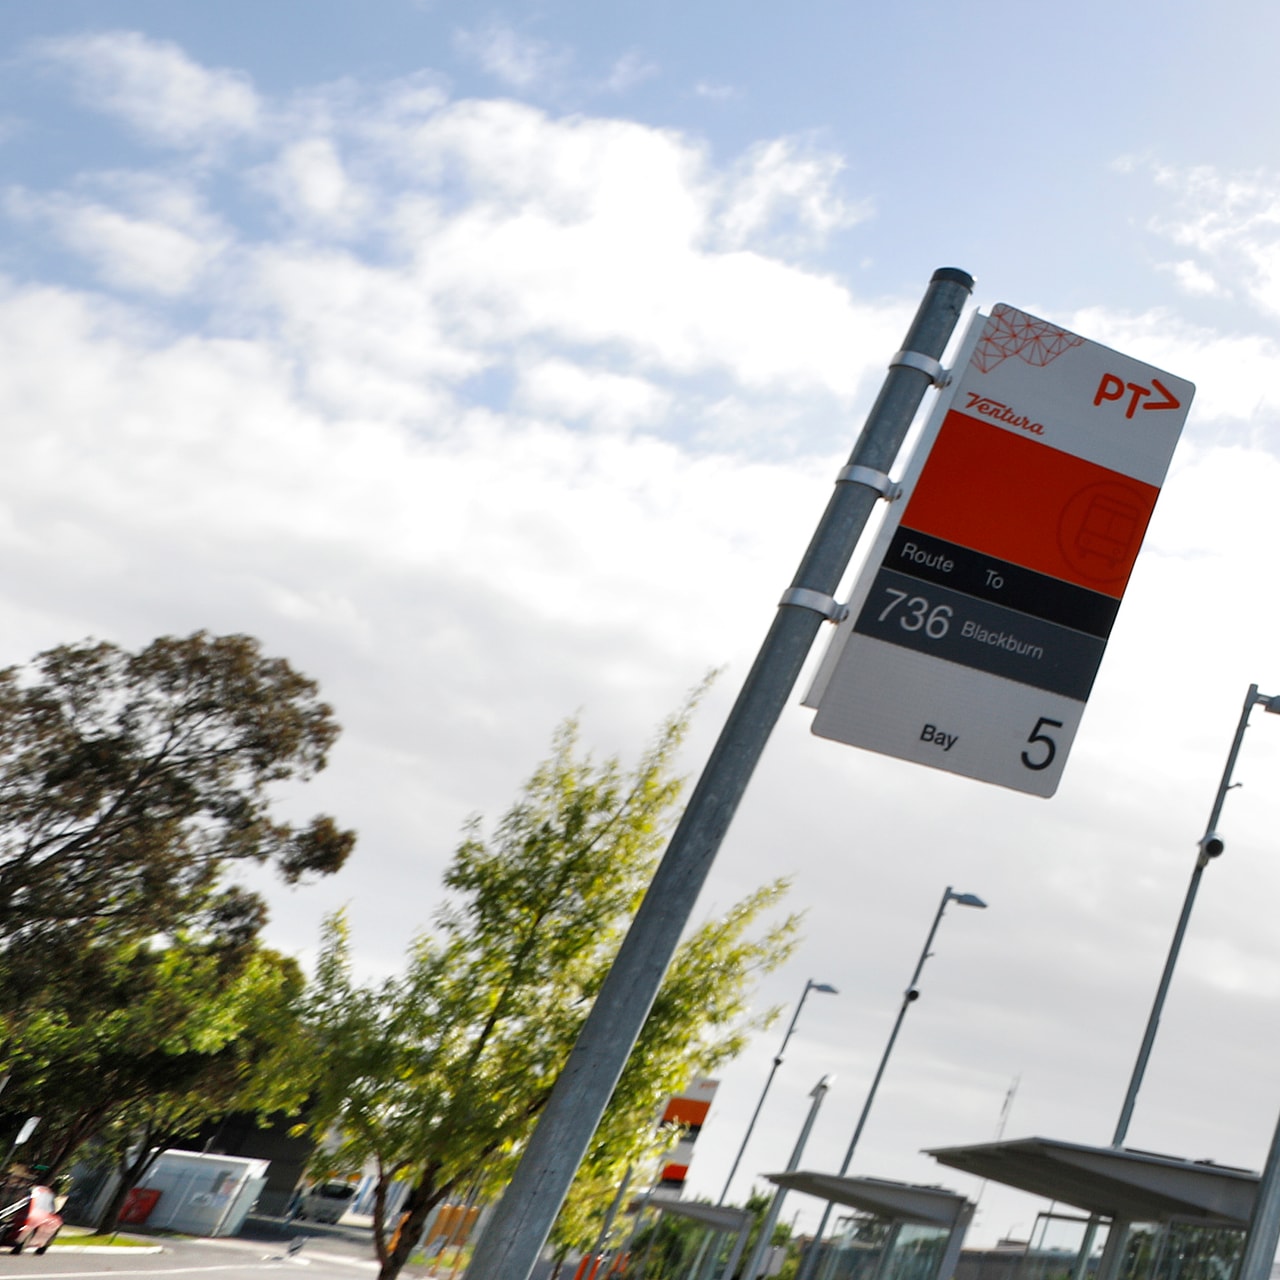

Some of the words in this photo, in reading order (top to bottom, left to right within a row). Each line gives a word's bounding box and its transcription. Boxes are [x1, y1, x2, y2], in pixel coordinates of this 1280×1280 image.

[966, 392, 1045, 436] Ventura
[901, 542, 954, 573] Route
[985, 569, 1005, 590] To
[878, 588, 953, 640] 736
[961, 621, 1044, 660] Blackburn
[920, 724, 959, 752] Bay
[1020, 717, 1064, 772] 5
